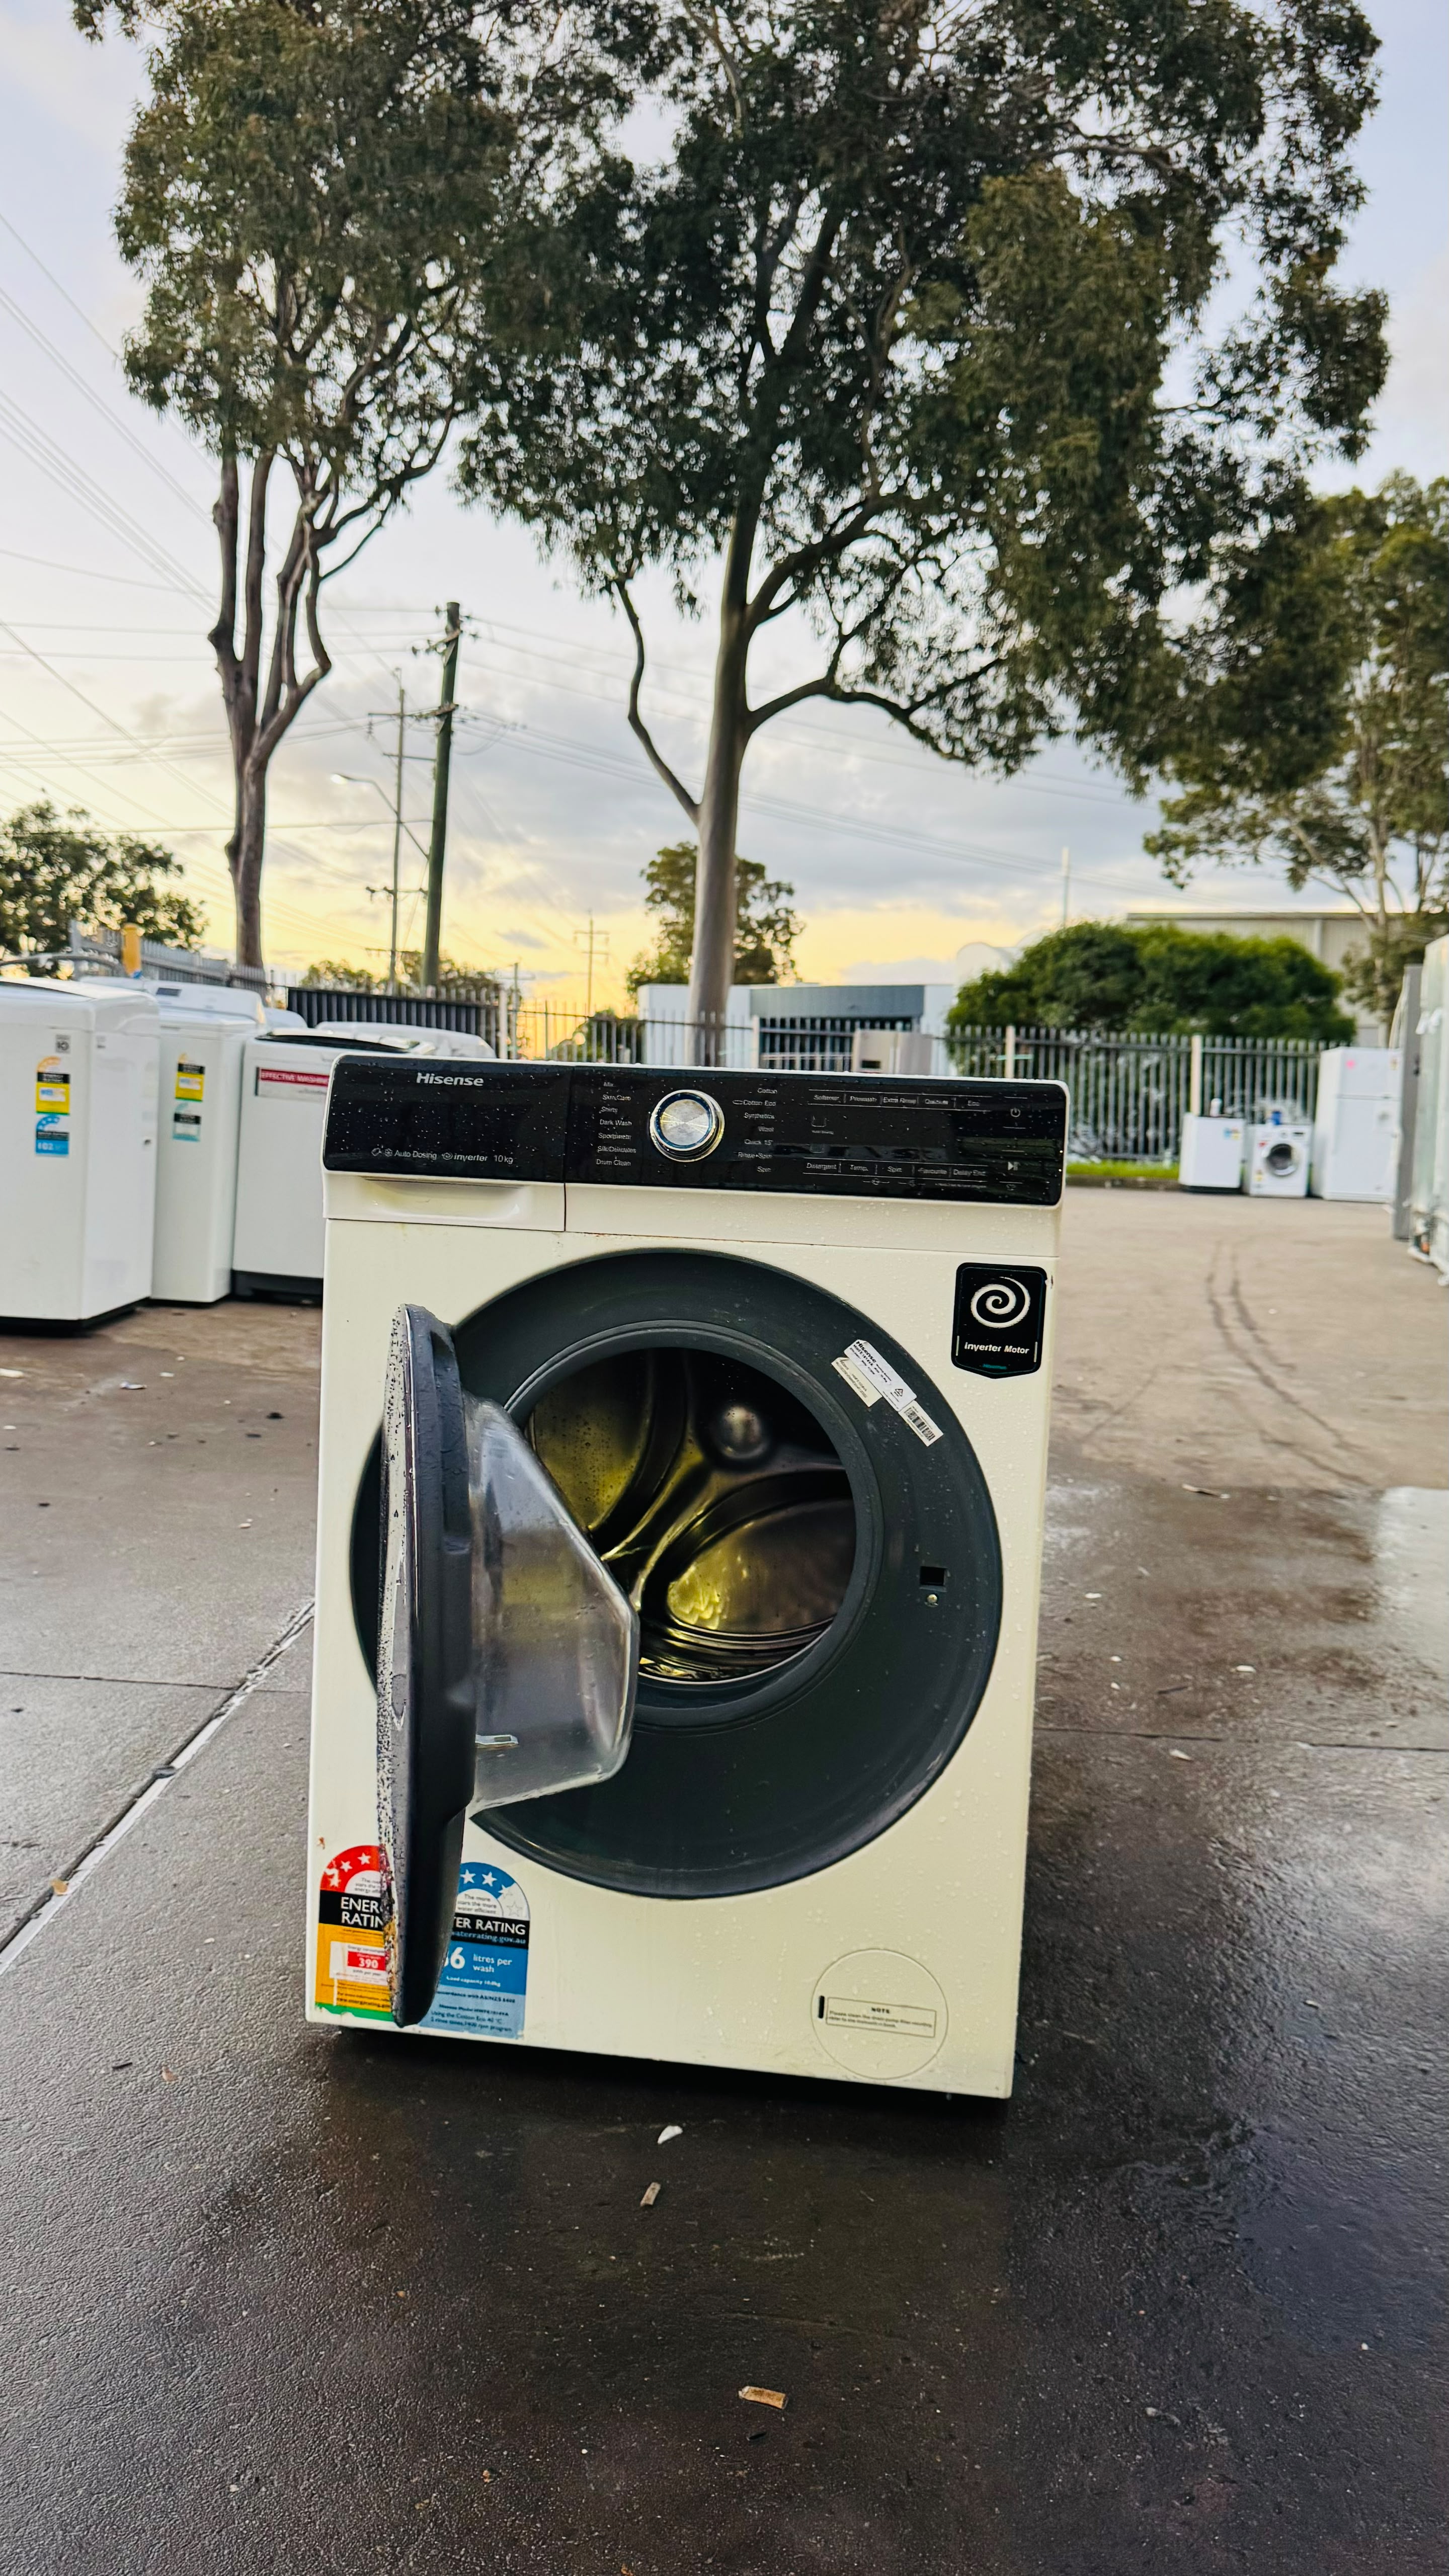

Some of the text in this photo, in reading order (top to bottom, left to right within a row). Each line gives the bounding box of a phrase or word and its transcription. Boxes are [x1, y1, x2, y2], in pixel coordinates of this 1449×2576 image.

[416, 1072, 484, 1086] Hisense
[394, 1150, 437, 1160] Auto Dosing
[454, 1153, 488, 1162] inverter
[856, 1341, 876, 1363] Hisense
[964, 1342, 1030, 1354] inverter Motor
[341, 1896, 383, 1914] ENER
[341, 1910, 384, 1928] RATIN
[475, 1919, 526, 1936] RATING
[358, 1957, 379, 1969] 390
[472, 1954, 495, 1964] litres
[497, 1958, 513, 1967] per
[472, 1964, 495, 1973] wash
